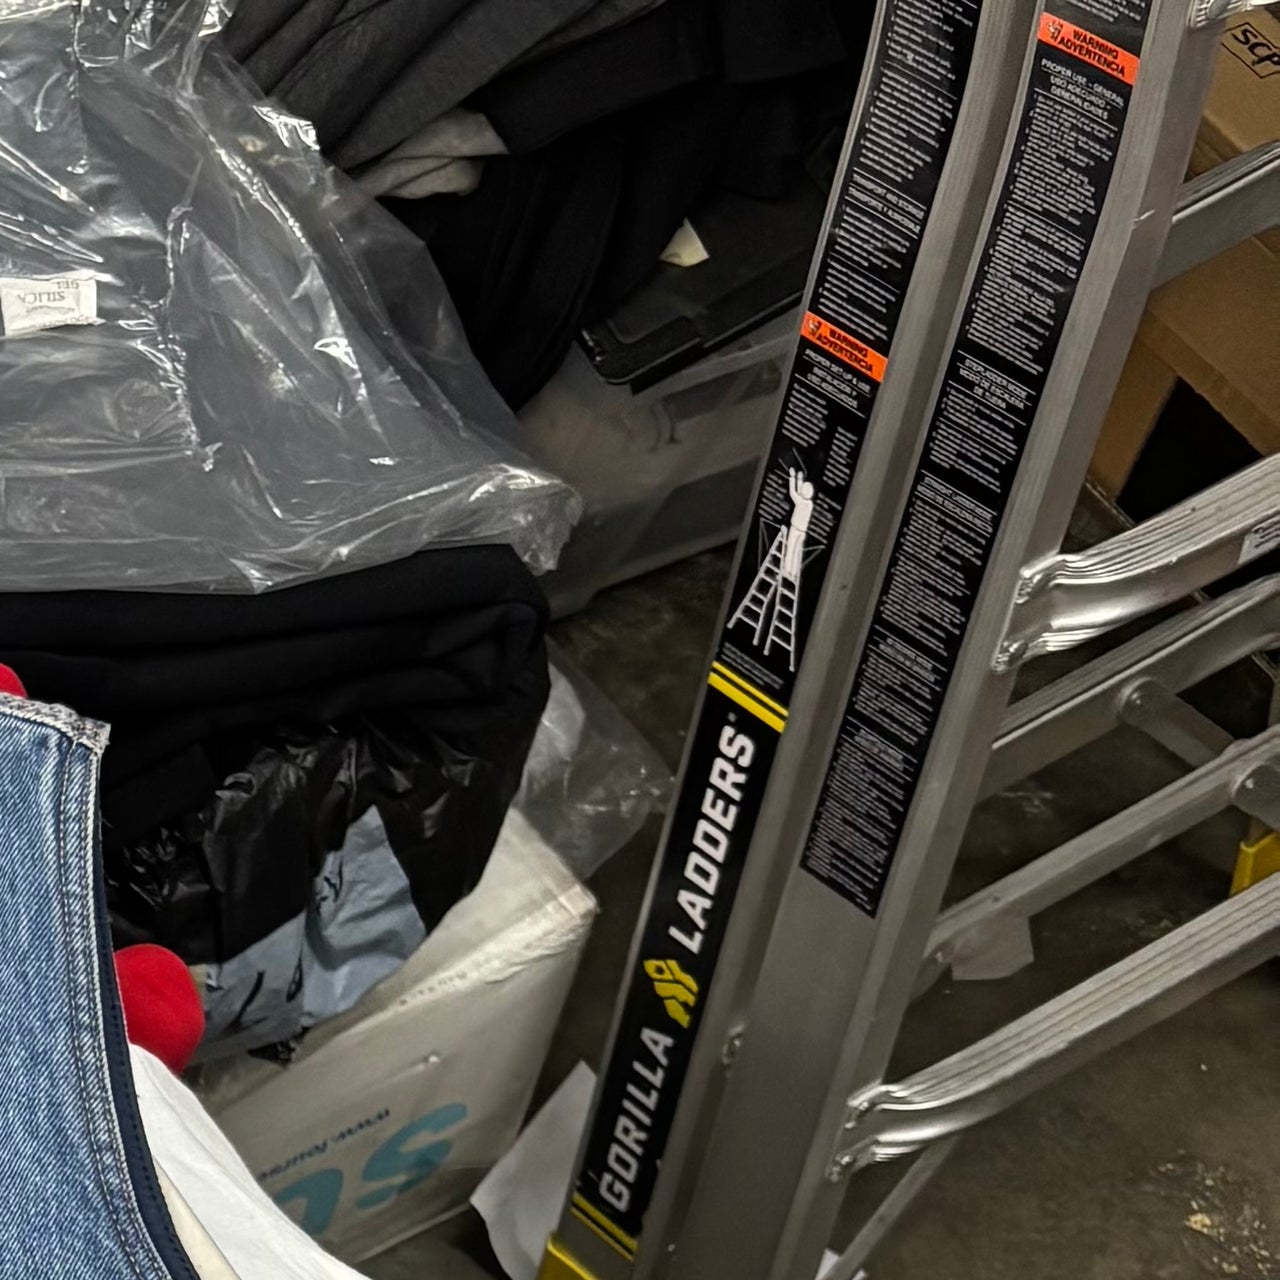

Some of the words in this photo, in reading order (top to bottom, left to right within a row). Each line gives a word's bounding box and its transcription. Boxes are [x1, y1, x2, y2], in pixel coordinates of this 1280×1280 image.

[1072, 29, 1119, 60] WARNING
[17, 290, 66, 305] SILICA
[668, 725, 758, 955] LADDERS
[599, 1026, 676, 1213] GORILLA
